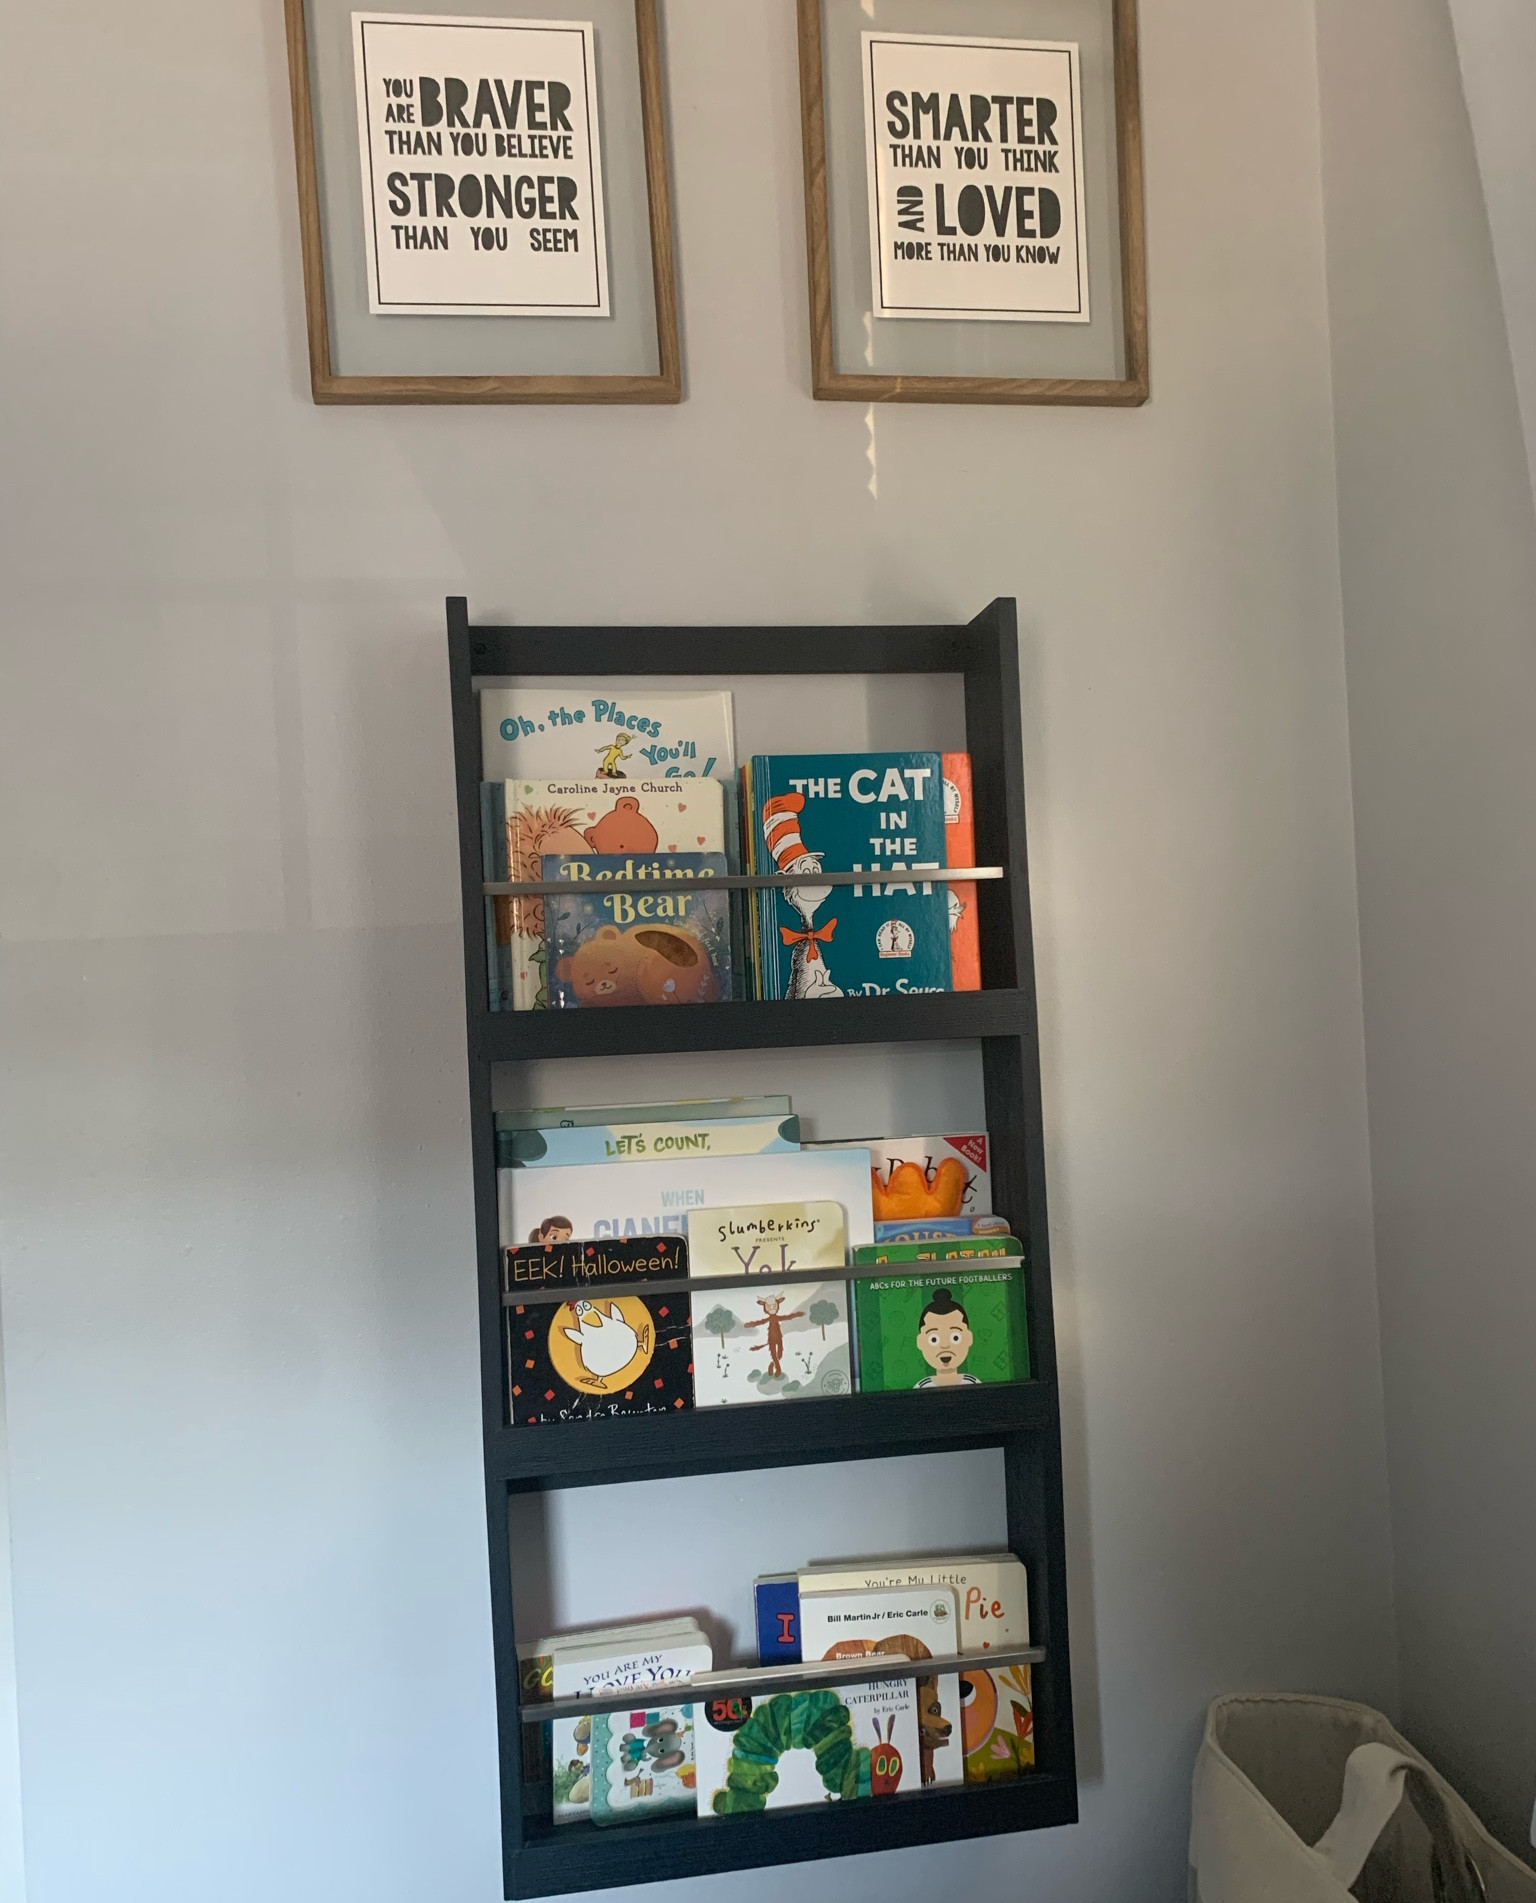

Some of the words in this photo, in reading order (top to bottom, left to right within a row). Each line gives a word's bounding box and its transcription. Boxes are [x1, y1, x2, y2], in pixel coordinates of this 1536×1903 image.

[383, 78, 414, 98] YOU
[385, 103, 415, 124] ARE
[418, 77, 574, 131] BRAVER
[885, 90, 1059, 146] SMARTER
[384, 130, 442, 156] THAN
[450, 133, 487, 157] YOU
[495, 134, 573, 160] BELIEVE
[889, 144, 942, 169] THAN
[954, 147, 988, 171] YOU
[1000, 148, 1060, 173] THINK
[386, 171, 579, 220] STRONGER
[896, 185, 925, 233] AND
[935, 183, 1061, 239] LOVED
[390, 225, 449, 251] THAN
[470, 227, 508, 251] YOU
[529, 228, 579, 253] SEEM
[893, 241, 933, 261] MORE
[937, 242, 979, 263] THAN
[983, 244, 1011, 263] YOU
[1015, 245, 1060, 265] KNOW
[499, 716, 545, 741] Oh,
[548, 706, 586, 727] the
[591, 699, 662, 738] Places
[639, 740, 696, 766] You'll
[547, 784, 598, 794] Caroline
[603, 783, 636, 795] Jayne
[641, 782, 683, 793] Church
[789, 778, 842, 799] THE
[848, 768, 931, 804] CAT
[880, 811, 907, 830] IN
[869, 837, 917, 856] THE
[852, 862, 940, 898] HAT
[603, 893, 692, 924] Bear
[605, 1133, 646, 1156] LET'S
[661, 1189, 704, 1207] WHEN
[513, 1254, 565, 1282] EEK!
[571, 1246, 680, 1277] Halloween!
[870, 1282, 889, 1291] ABCs
[890, 1281, 906, 1289] FOR
[909, 1279, 924, 1287] THE
[925, 1276, 957, 1286] FUTURE
[958, 1272, 1013, 1285] FOOTBALLERS
[827, 1615, 841, 1623] Bill
[843, 1614, 871, 1622] Martin
[887, 1611, 904, 1619] Eric
[905, 1609, 929, 1618] Carle
[964, 1586, 1005, 1620] Pie
[583, 1671, 610, 1685] YOU
[614, 1660, 639, 1675] ARE
[642, 1654, 663, 1668] MY
[835, 1652, 863, 1660] Brown
[845, 1690, 910, 1705] CATERPILLAR
[868, 1678, 908, 1691] HUNGRY
